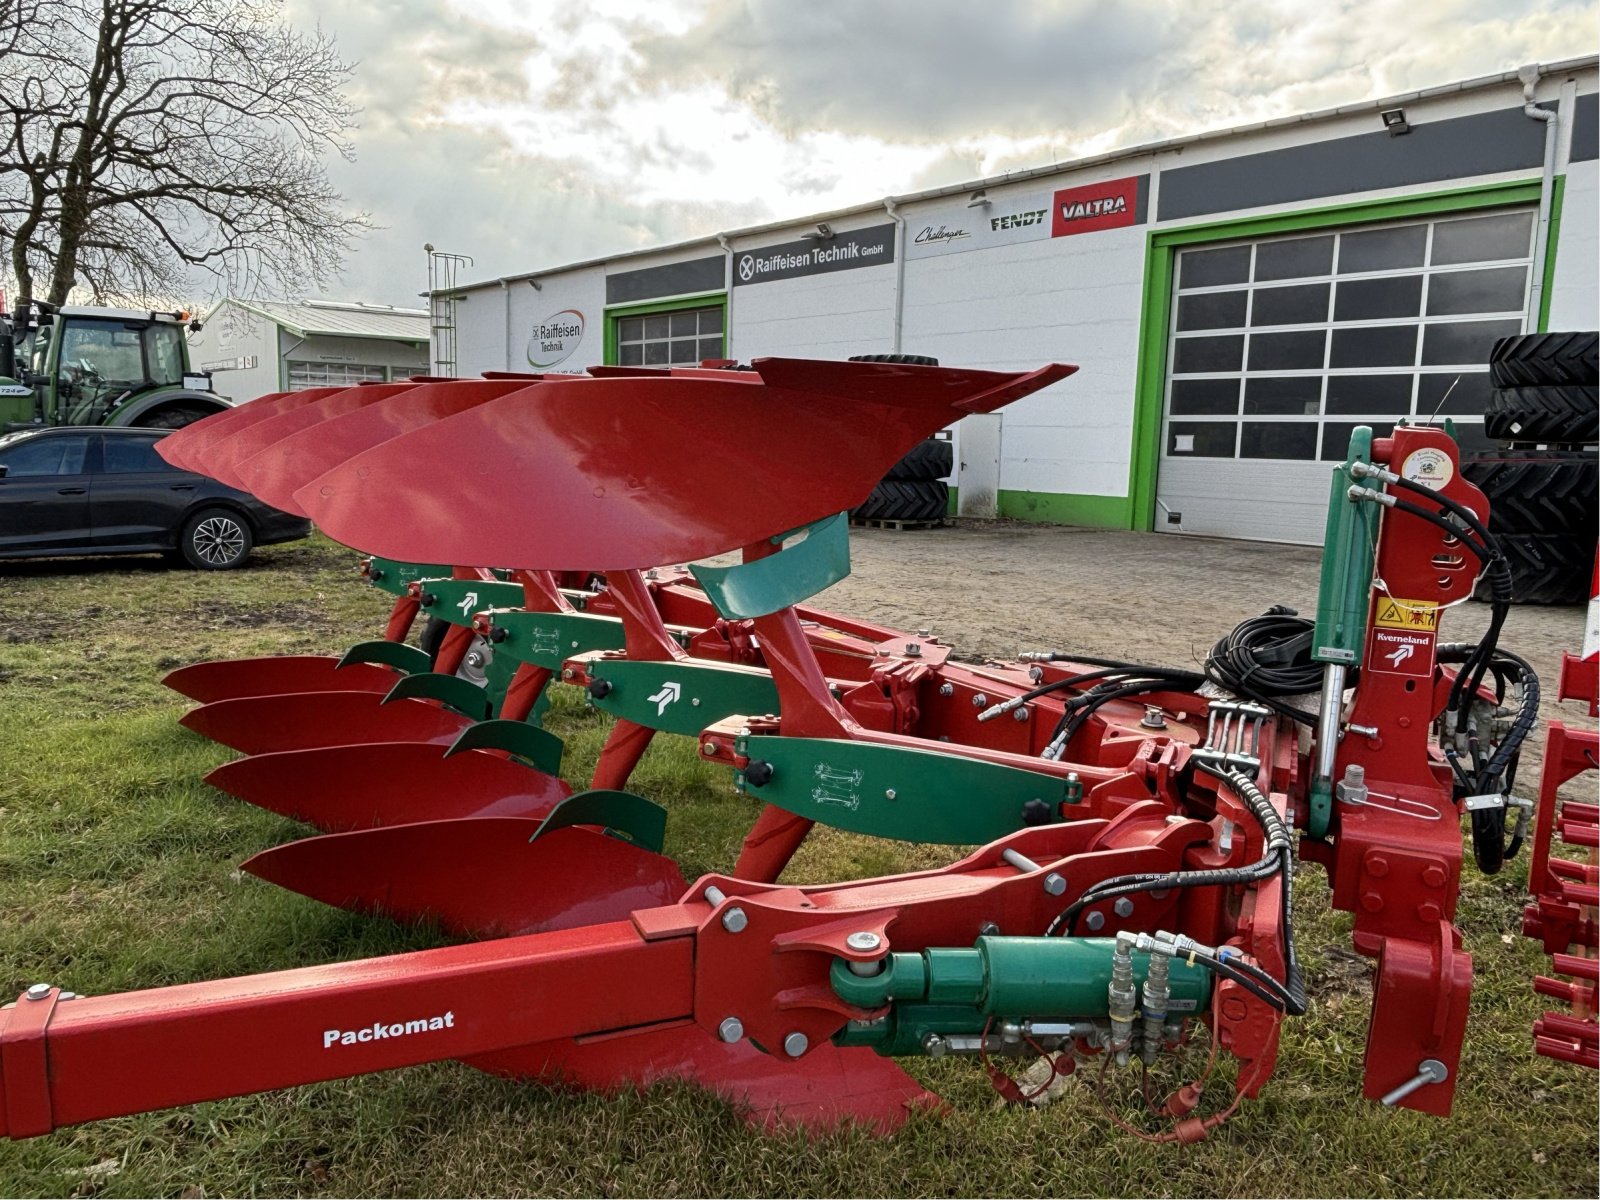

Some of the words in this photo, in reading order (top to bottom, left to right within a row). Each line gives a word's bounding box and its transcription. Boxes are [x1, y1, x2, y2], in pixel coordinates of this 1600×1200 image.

[1061, 196, 1127, 222] VALTRA
[991, 209, 1047, 231] FENDT
[915, 226, 971, 243] Challenger
[756, 252, 810, 274] Raiffeisen
[812, 242, 859, 264] Technik
[861, 244, 884, 257] GmbH
[540, 323, 580, 340] Raiffeisen
[540, 341, 563, 353] Technik
[1377, 633, 1429, 645] Kverneland
[323, 1011, 454, 1048] Packomat
